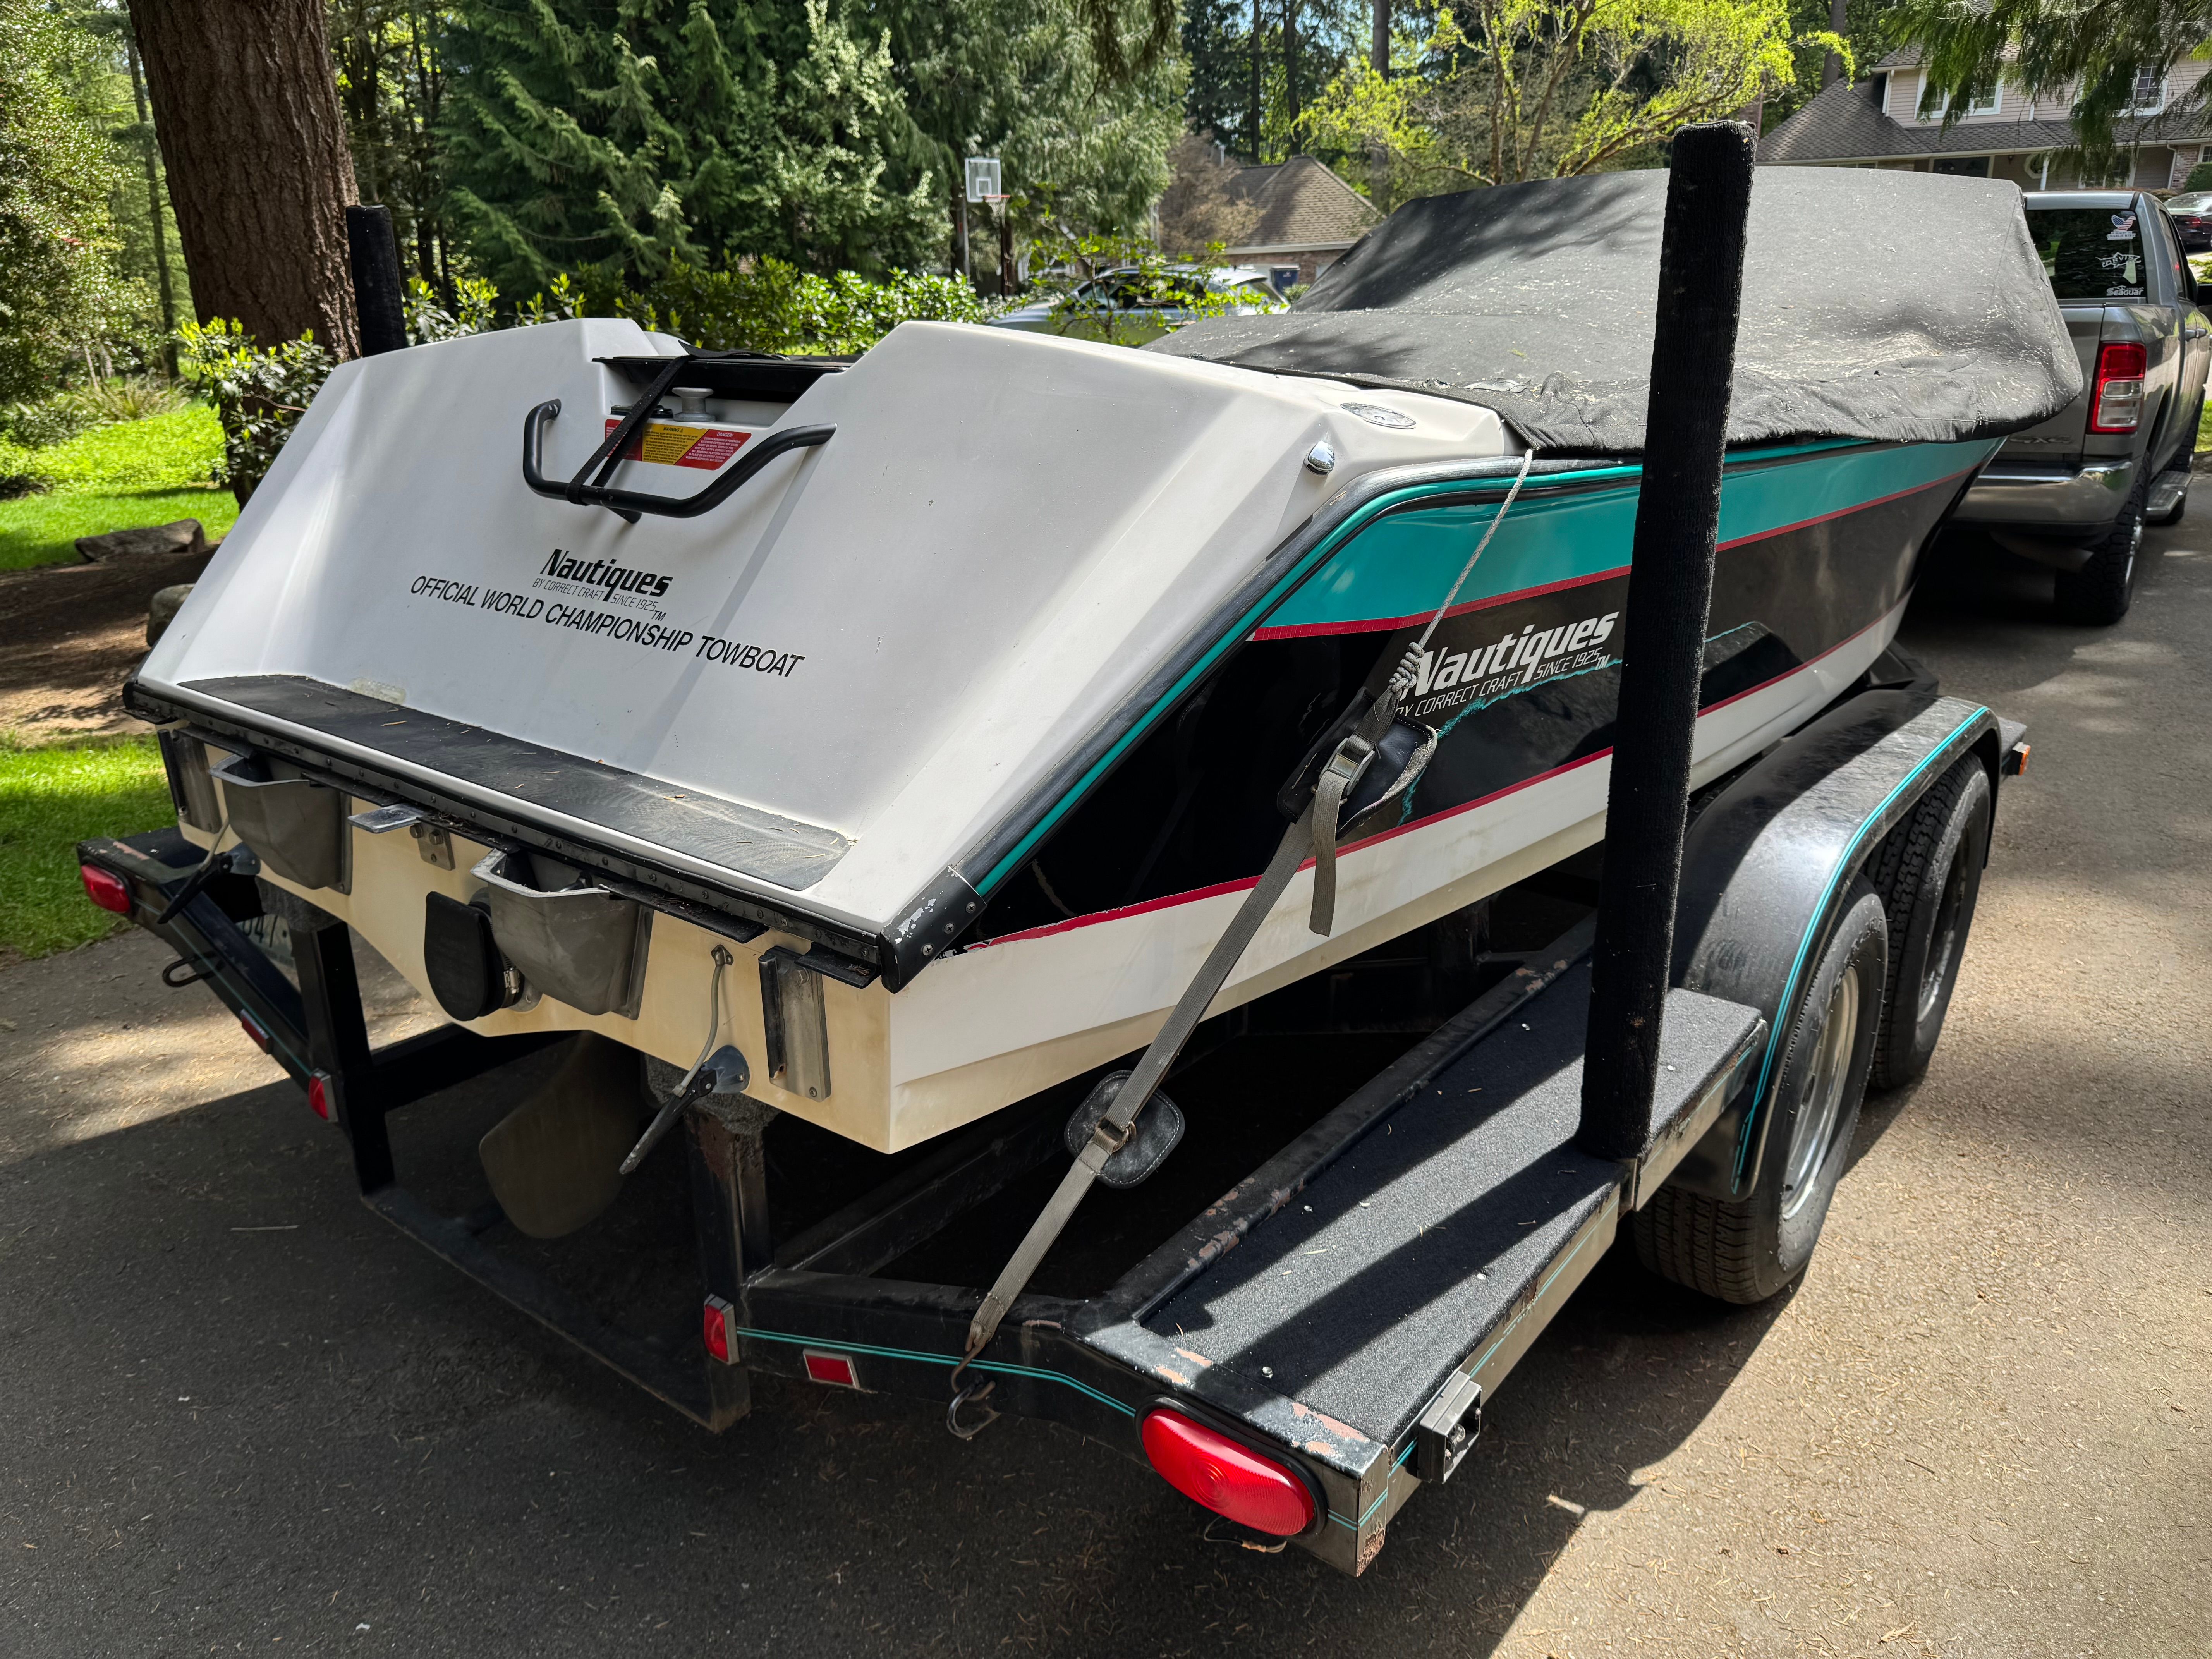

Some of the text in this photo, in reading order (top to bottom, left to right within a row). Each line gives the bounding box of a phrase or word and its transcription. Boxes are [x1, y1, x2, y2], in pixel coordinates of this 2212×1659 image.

[2106, 287, 2144, 296] Seaguar
[532, 578, 658, 611] BY CORRECT CRAFT SINCE 1925
[540, 549, 673, 602] Nautiques
[410, 576, 805, 678] OFFICIAL WORLD CHAMPIONSHIP TOWBOAT
[1400, 611, 1620, 701] Nautiques
[1415, 684, 1480, 716] CORRECT
[1479, 670, 1523, 697] CRAFT
[1534, 656, 1573, 680] SINCE
[1572, 647, 1604, 668] 1925
